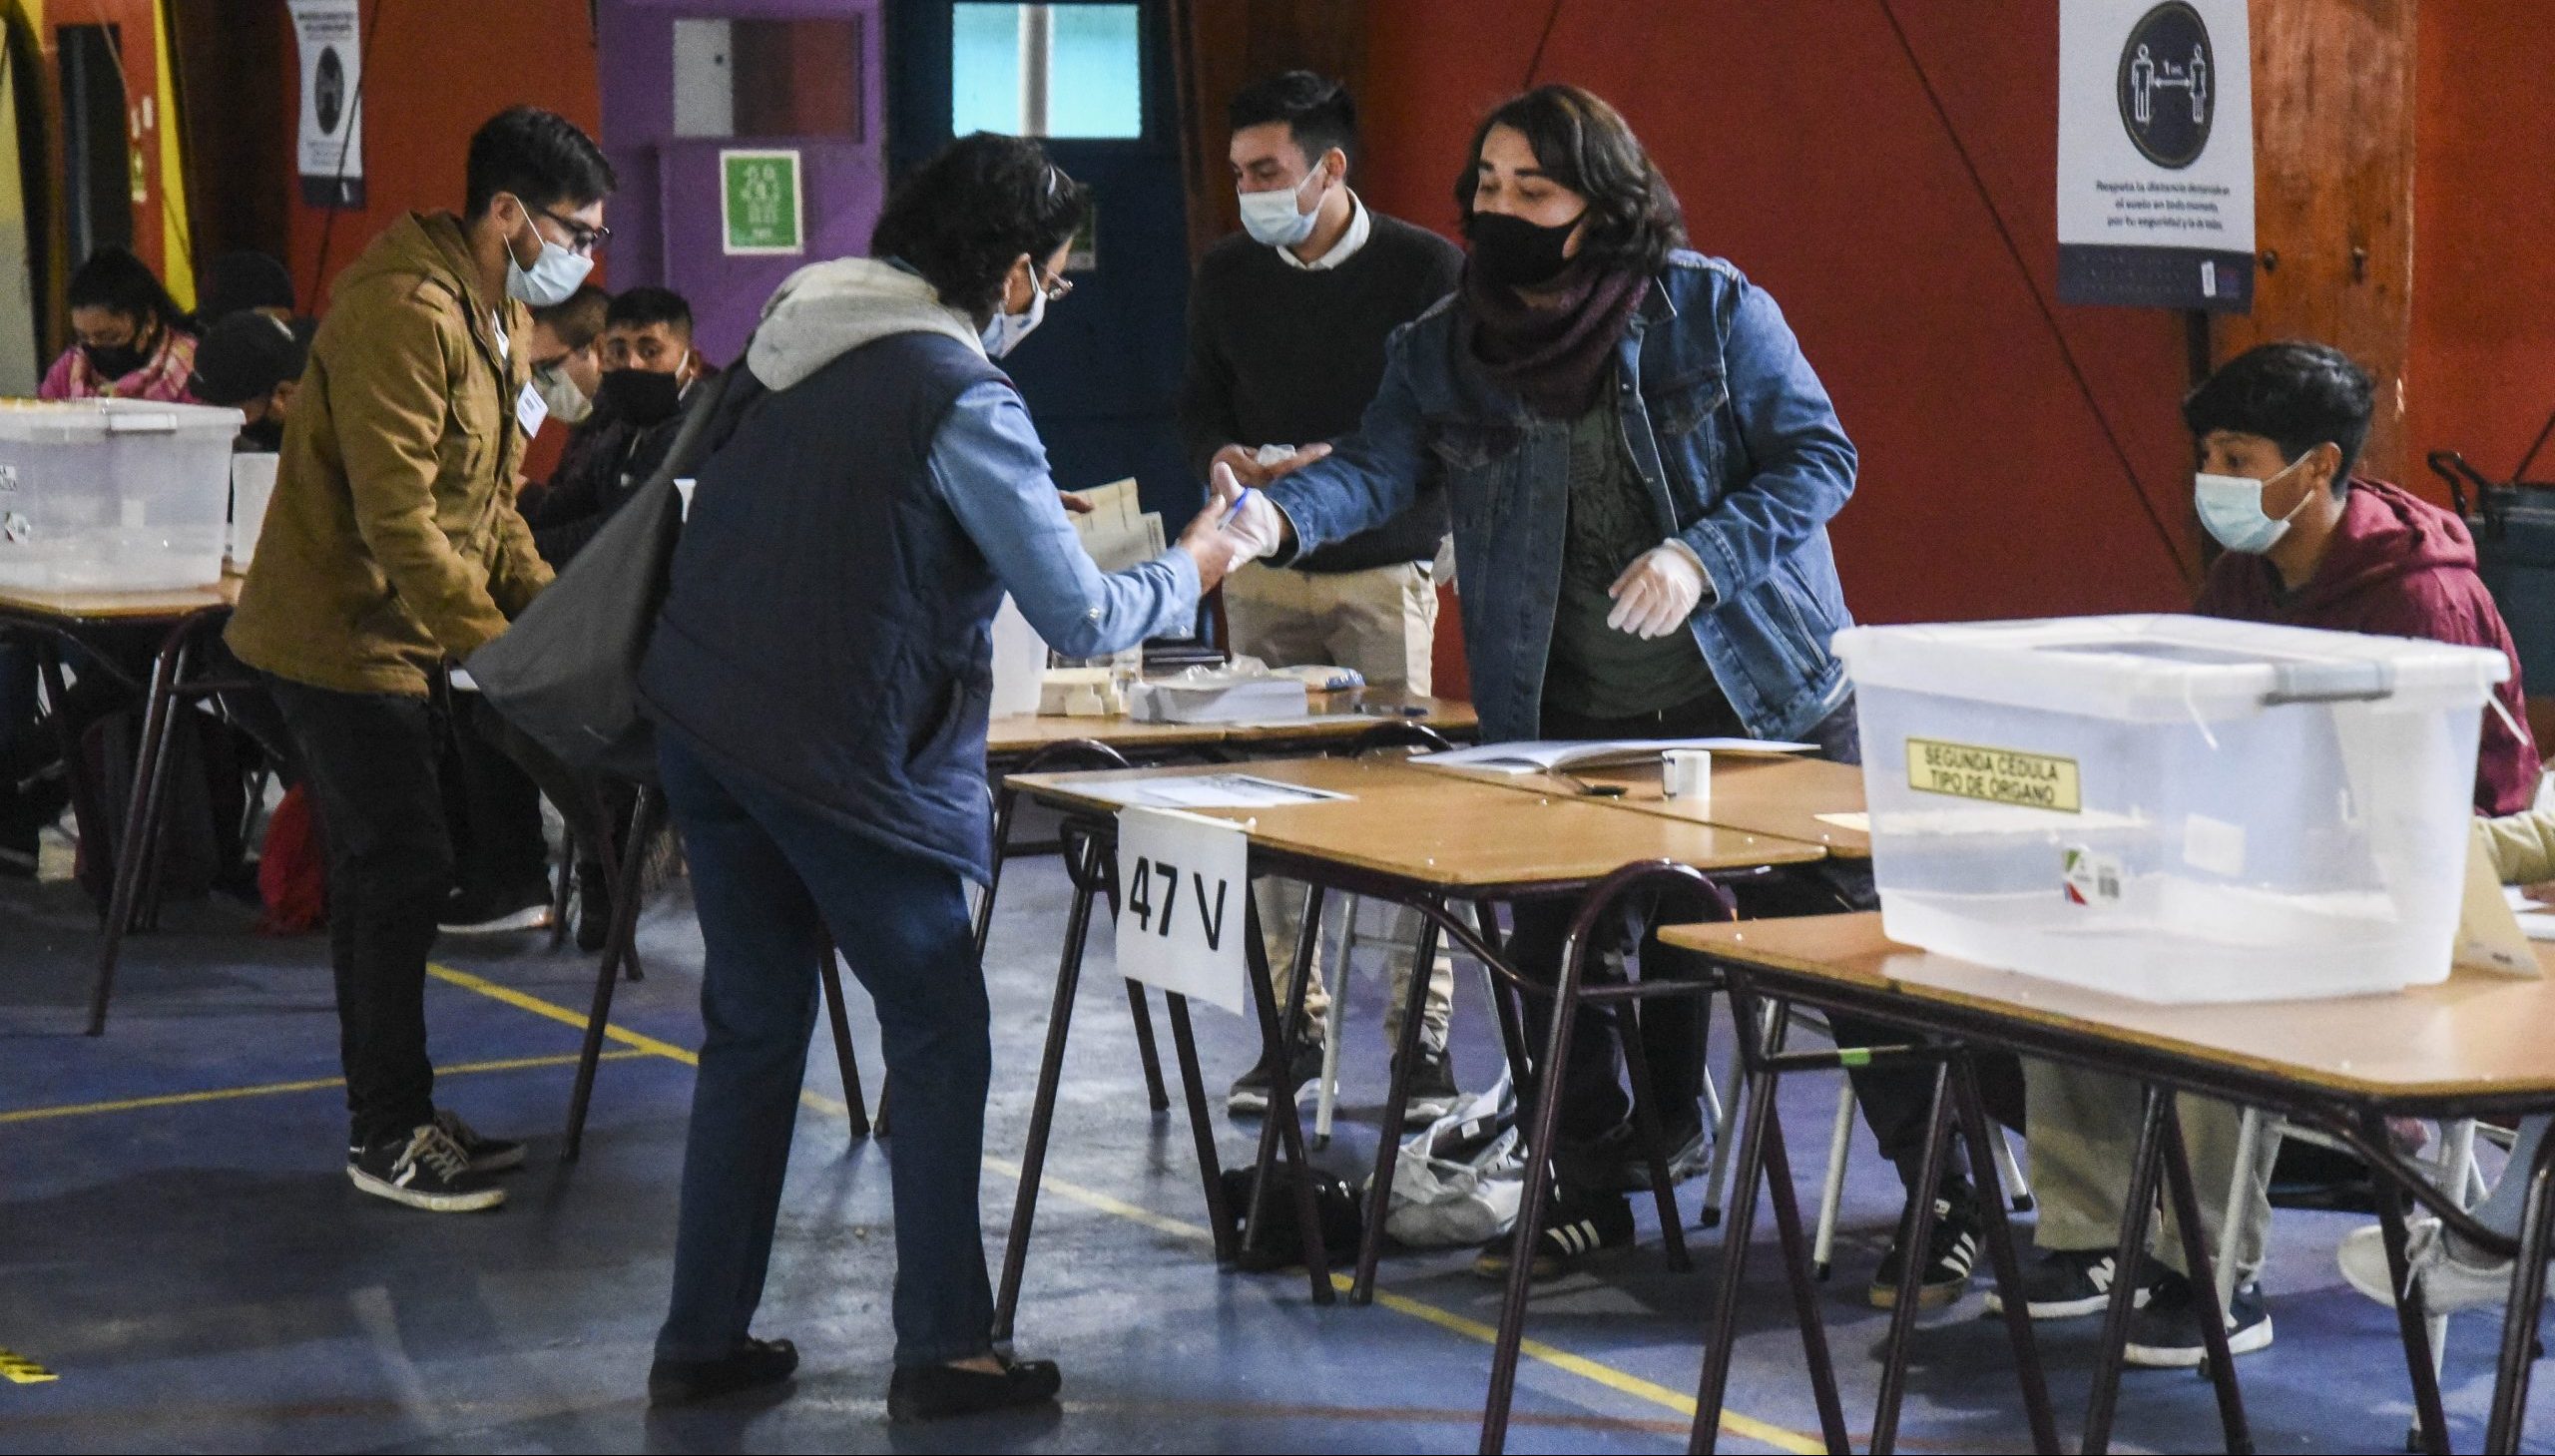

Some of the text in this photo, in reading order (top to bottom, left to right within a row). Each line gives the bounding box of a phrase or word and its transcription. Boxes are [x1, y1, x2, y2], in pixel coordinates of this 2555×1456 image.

[1925, 746, 1992, 771] SEGUNDA
[1931, 769, 1962, 791] TIPO
[1966, 774, 1984, 795] DE
[1130, 856, 1227, 951] 47 V
